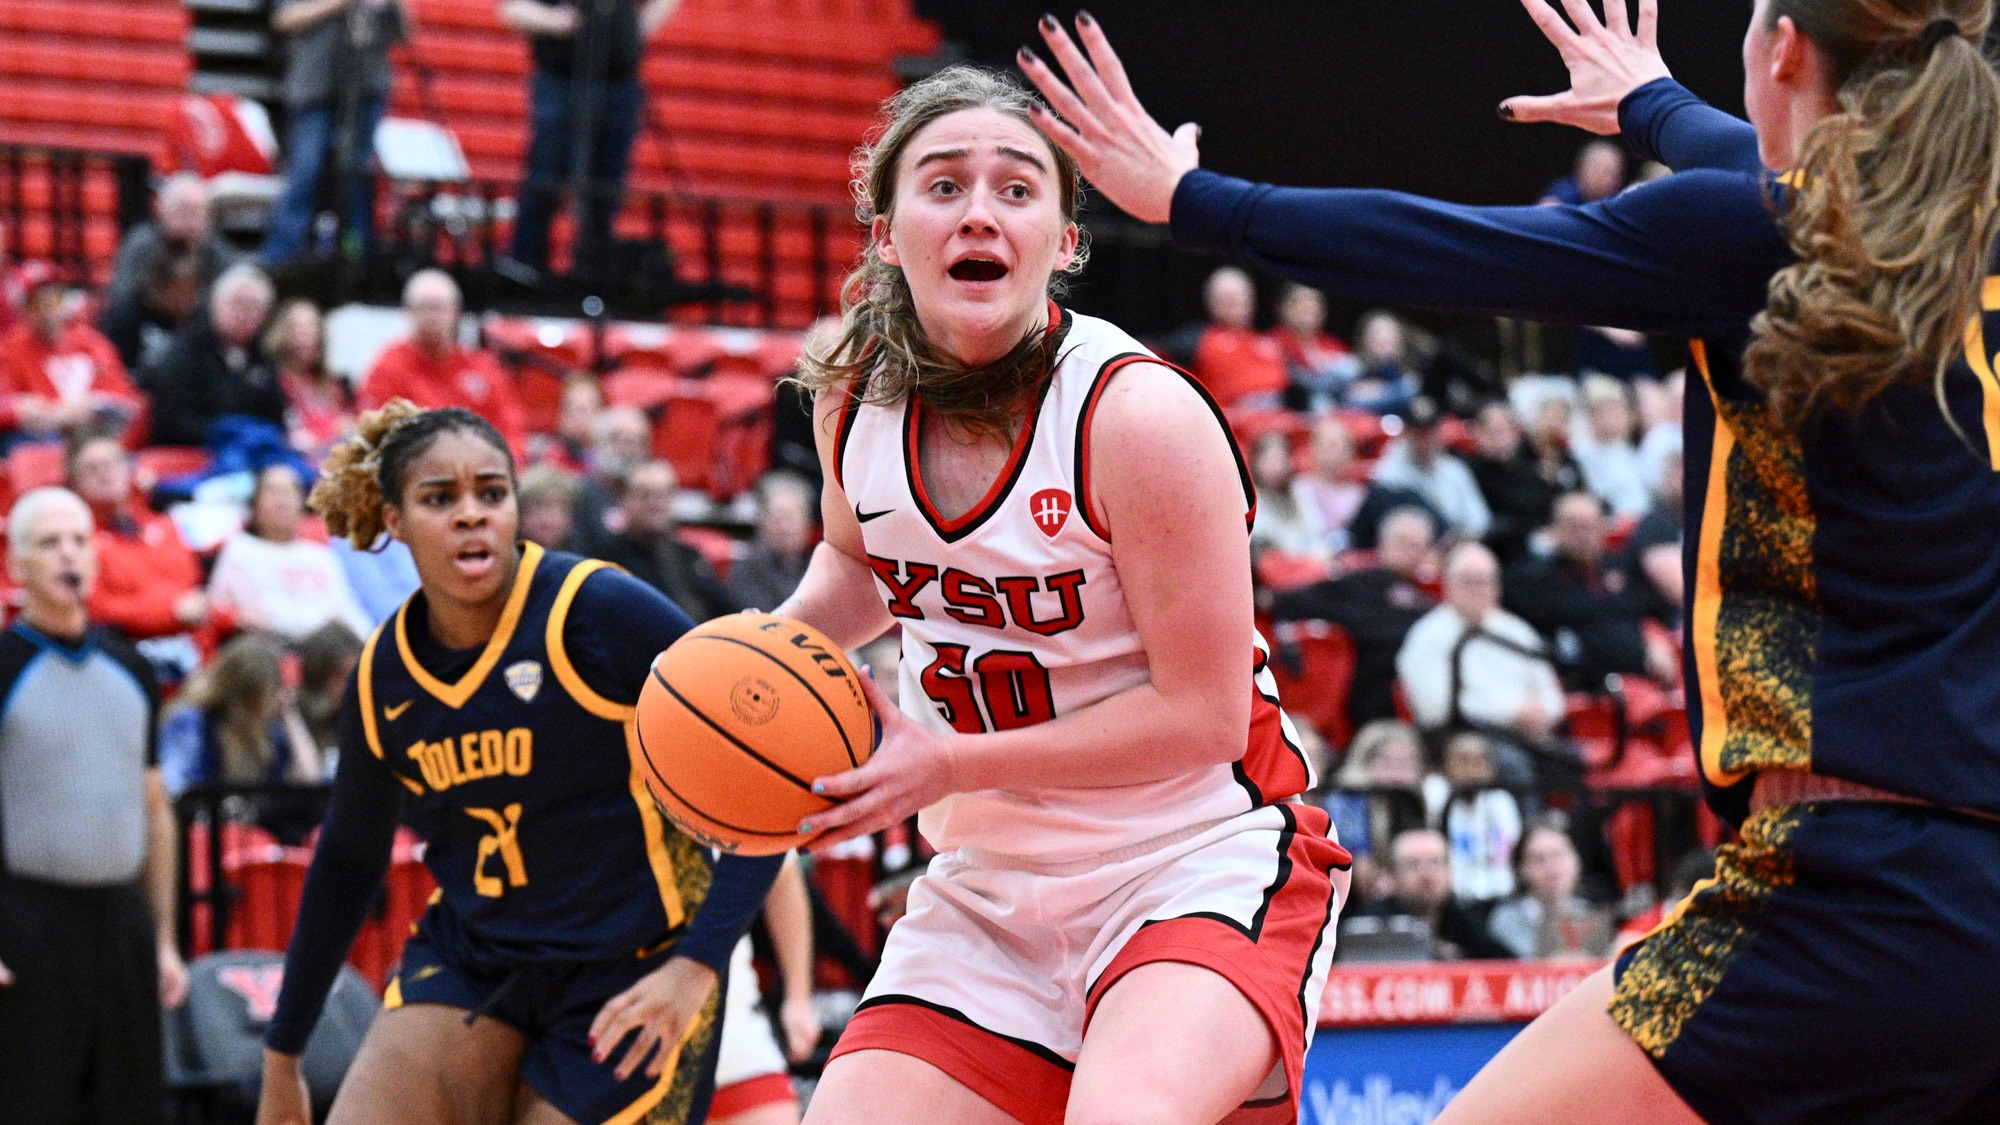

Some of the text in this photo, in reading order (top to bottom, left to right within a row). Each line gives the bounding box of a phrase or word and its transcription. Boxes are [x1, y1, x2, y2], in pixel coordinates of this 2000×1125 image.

[867, 553, 1086, 636] YSU
[920, 641, 1056, 734] 50
[407, 727, 533, 791] TOLEDO
[464, 802, 529, 898] 21
